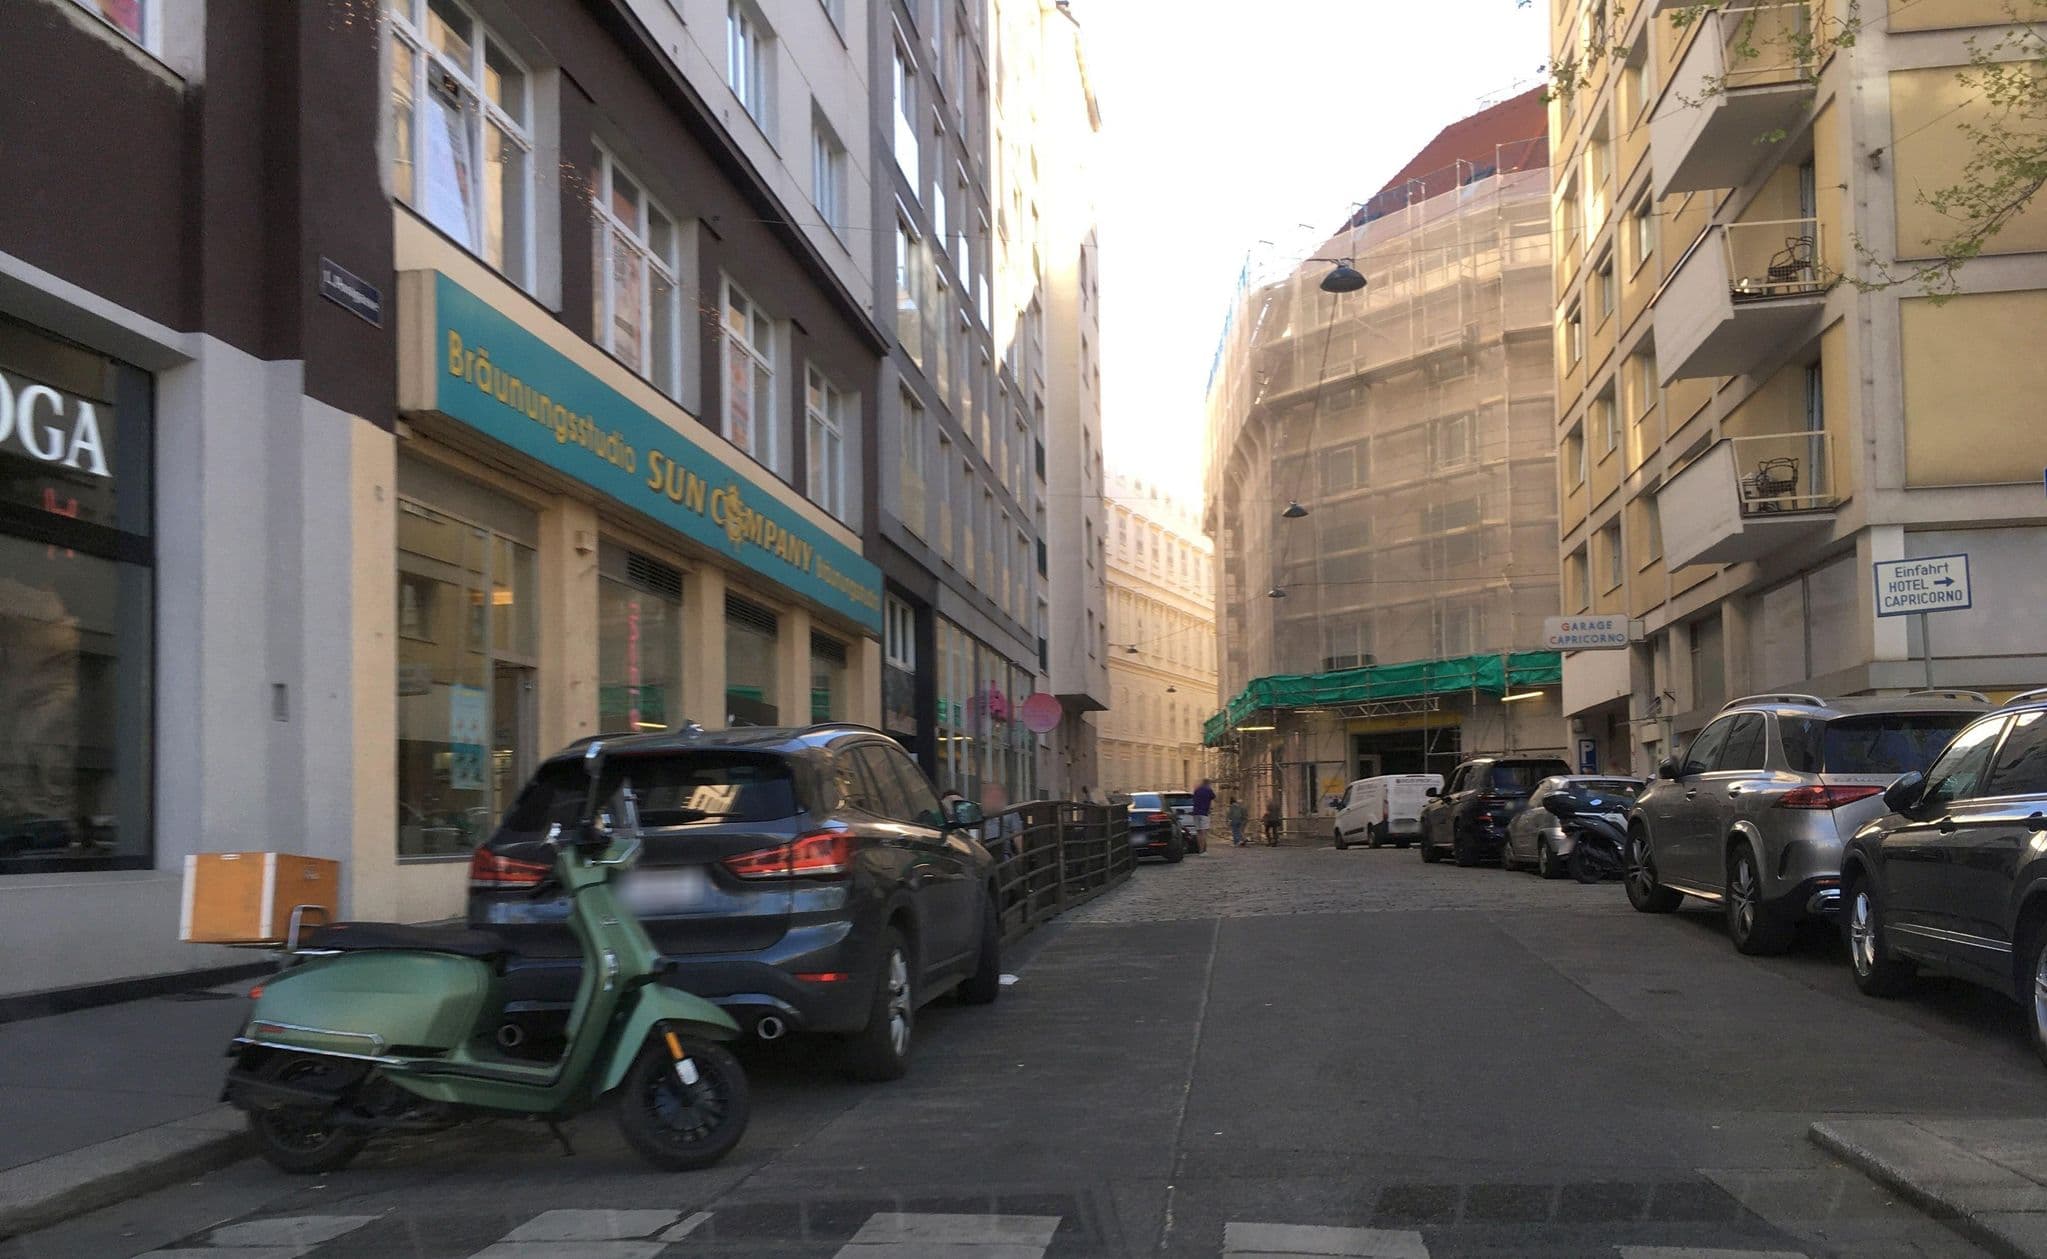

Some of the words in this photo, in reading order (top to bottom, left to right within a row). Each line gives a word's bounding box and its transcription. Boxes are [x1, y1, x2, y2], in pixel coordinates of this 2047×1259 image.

[448, 329, 636, 474] Bräunungsstudio
[647, 450, 707, 517] SUN
[711, 486, 815, 573] CMPANY
[1895, 562, 1949, 578] Einfahrt
[1888, 578, 1928, 593] HOTEL
[1884, 589, 1963, 608] CAPRICORNO
[1561, 620, 1613, 632] GARAGE
[1550, 633, 1625, 645] CAPRICORNO
[1581, 741, 1594, 764] P
